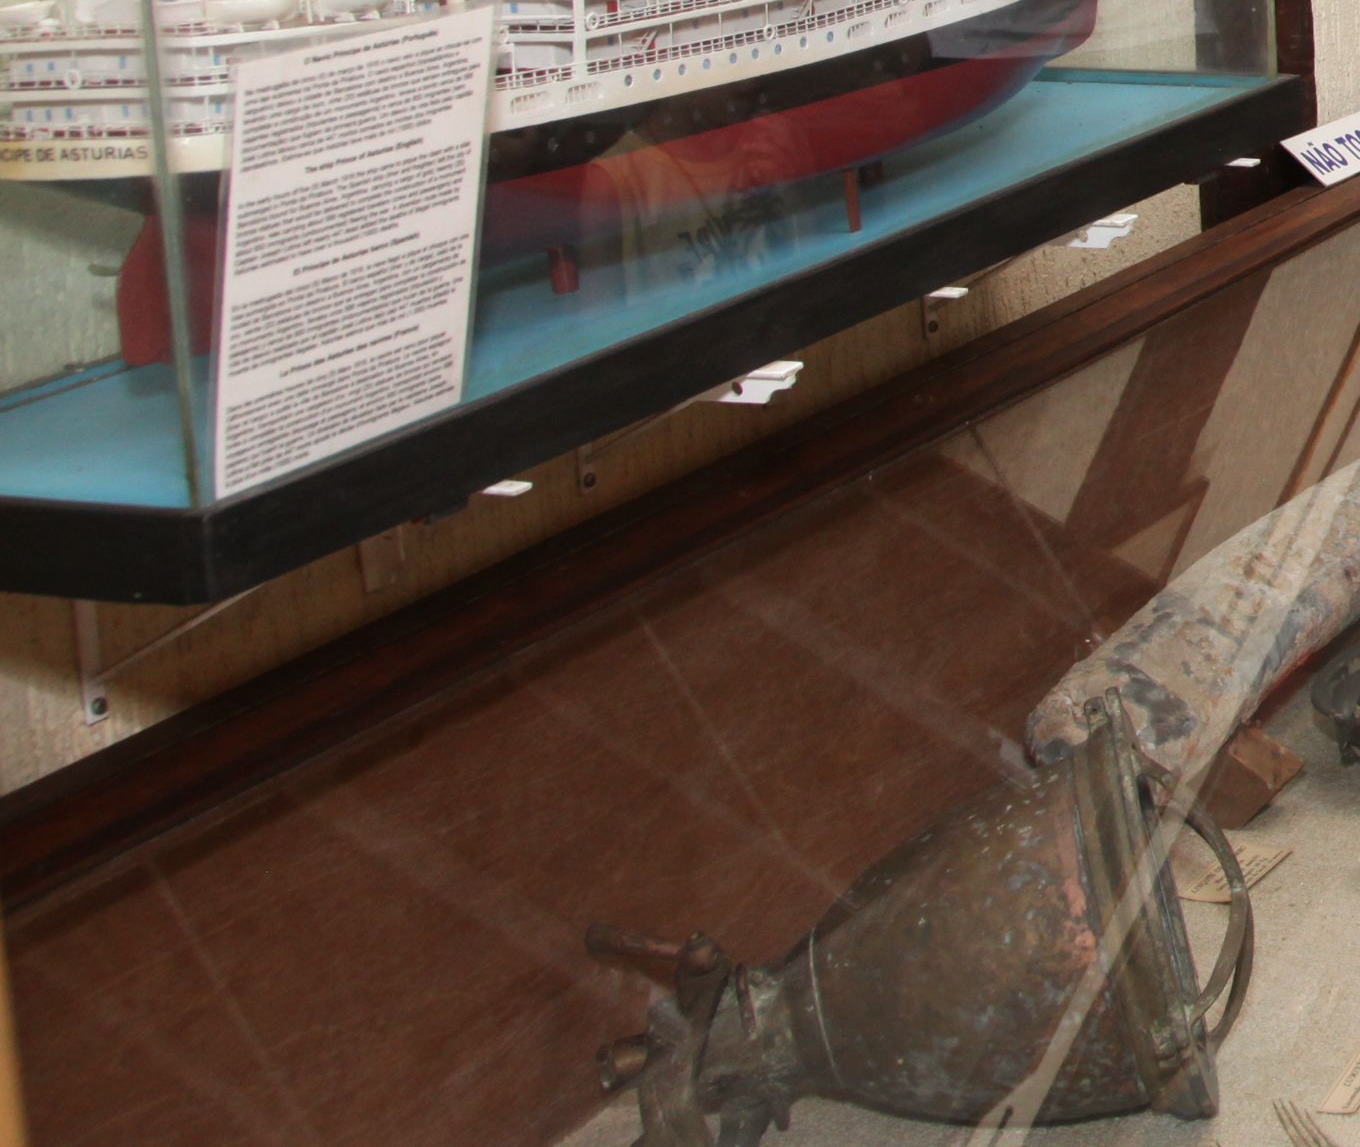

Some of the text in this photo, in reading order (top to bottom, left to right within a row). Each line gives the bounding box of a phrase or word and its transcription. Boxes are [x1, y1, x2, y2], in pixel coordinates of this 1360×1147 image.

[0, 145, 148, 163] CIPE DE ASTURIAS
[1300, 142, 1348, 175] NÃO
